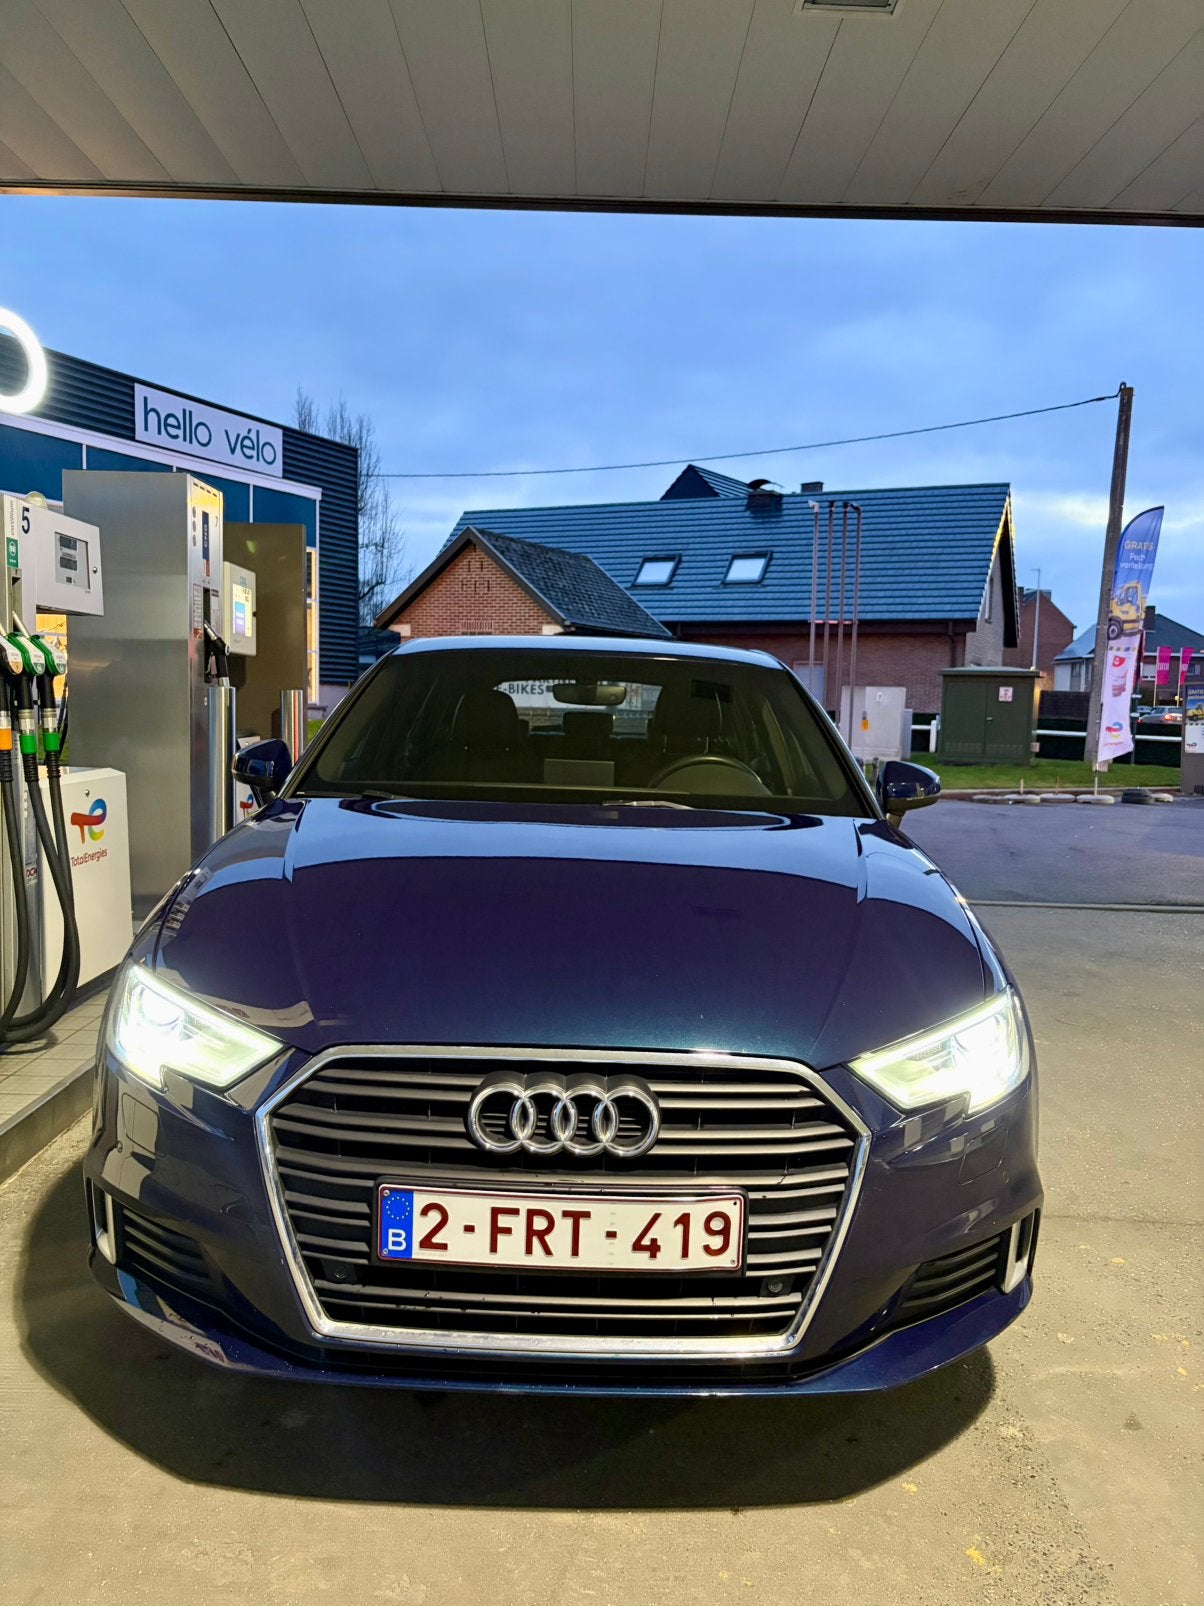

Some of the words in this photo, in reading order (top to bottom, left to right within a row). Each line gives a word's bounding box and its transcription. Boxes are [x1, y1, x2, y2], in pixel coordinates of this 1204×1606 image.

[142, 396, 212, 448] hello
[225, 428, 277, 466] vélo
[21, 506, 31, 535] 5
[70, 848, 108, 868] TotalEnergies
[387, 1228, 407, 1251] B
[418, 1202, 732, 1259] 2-FRT-419
